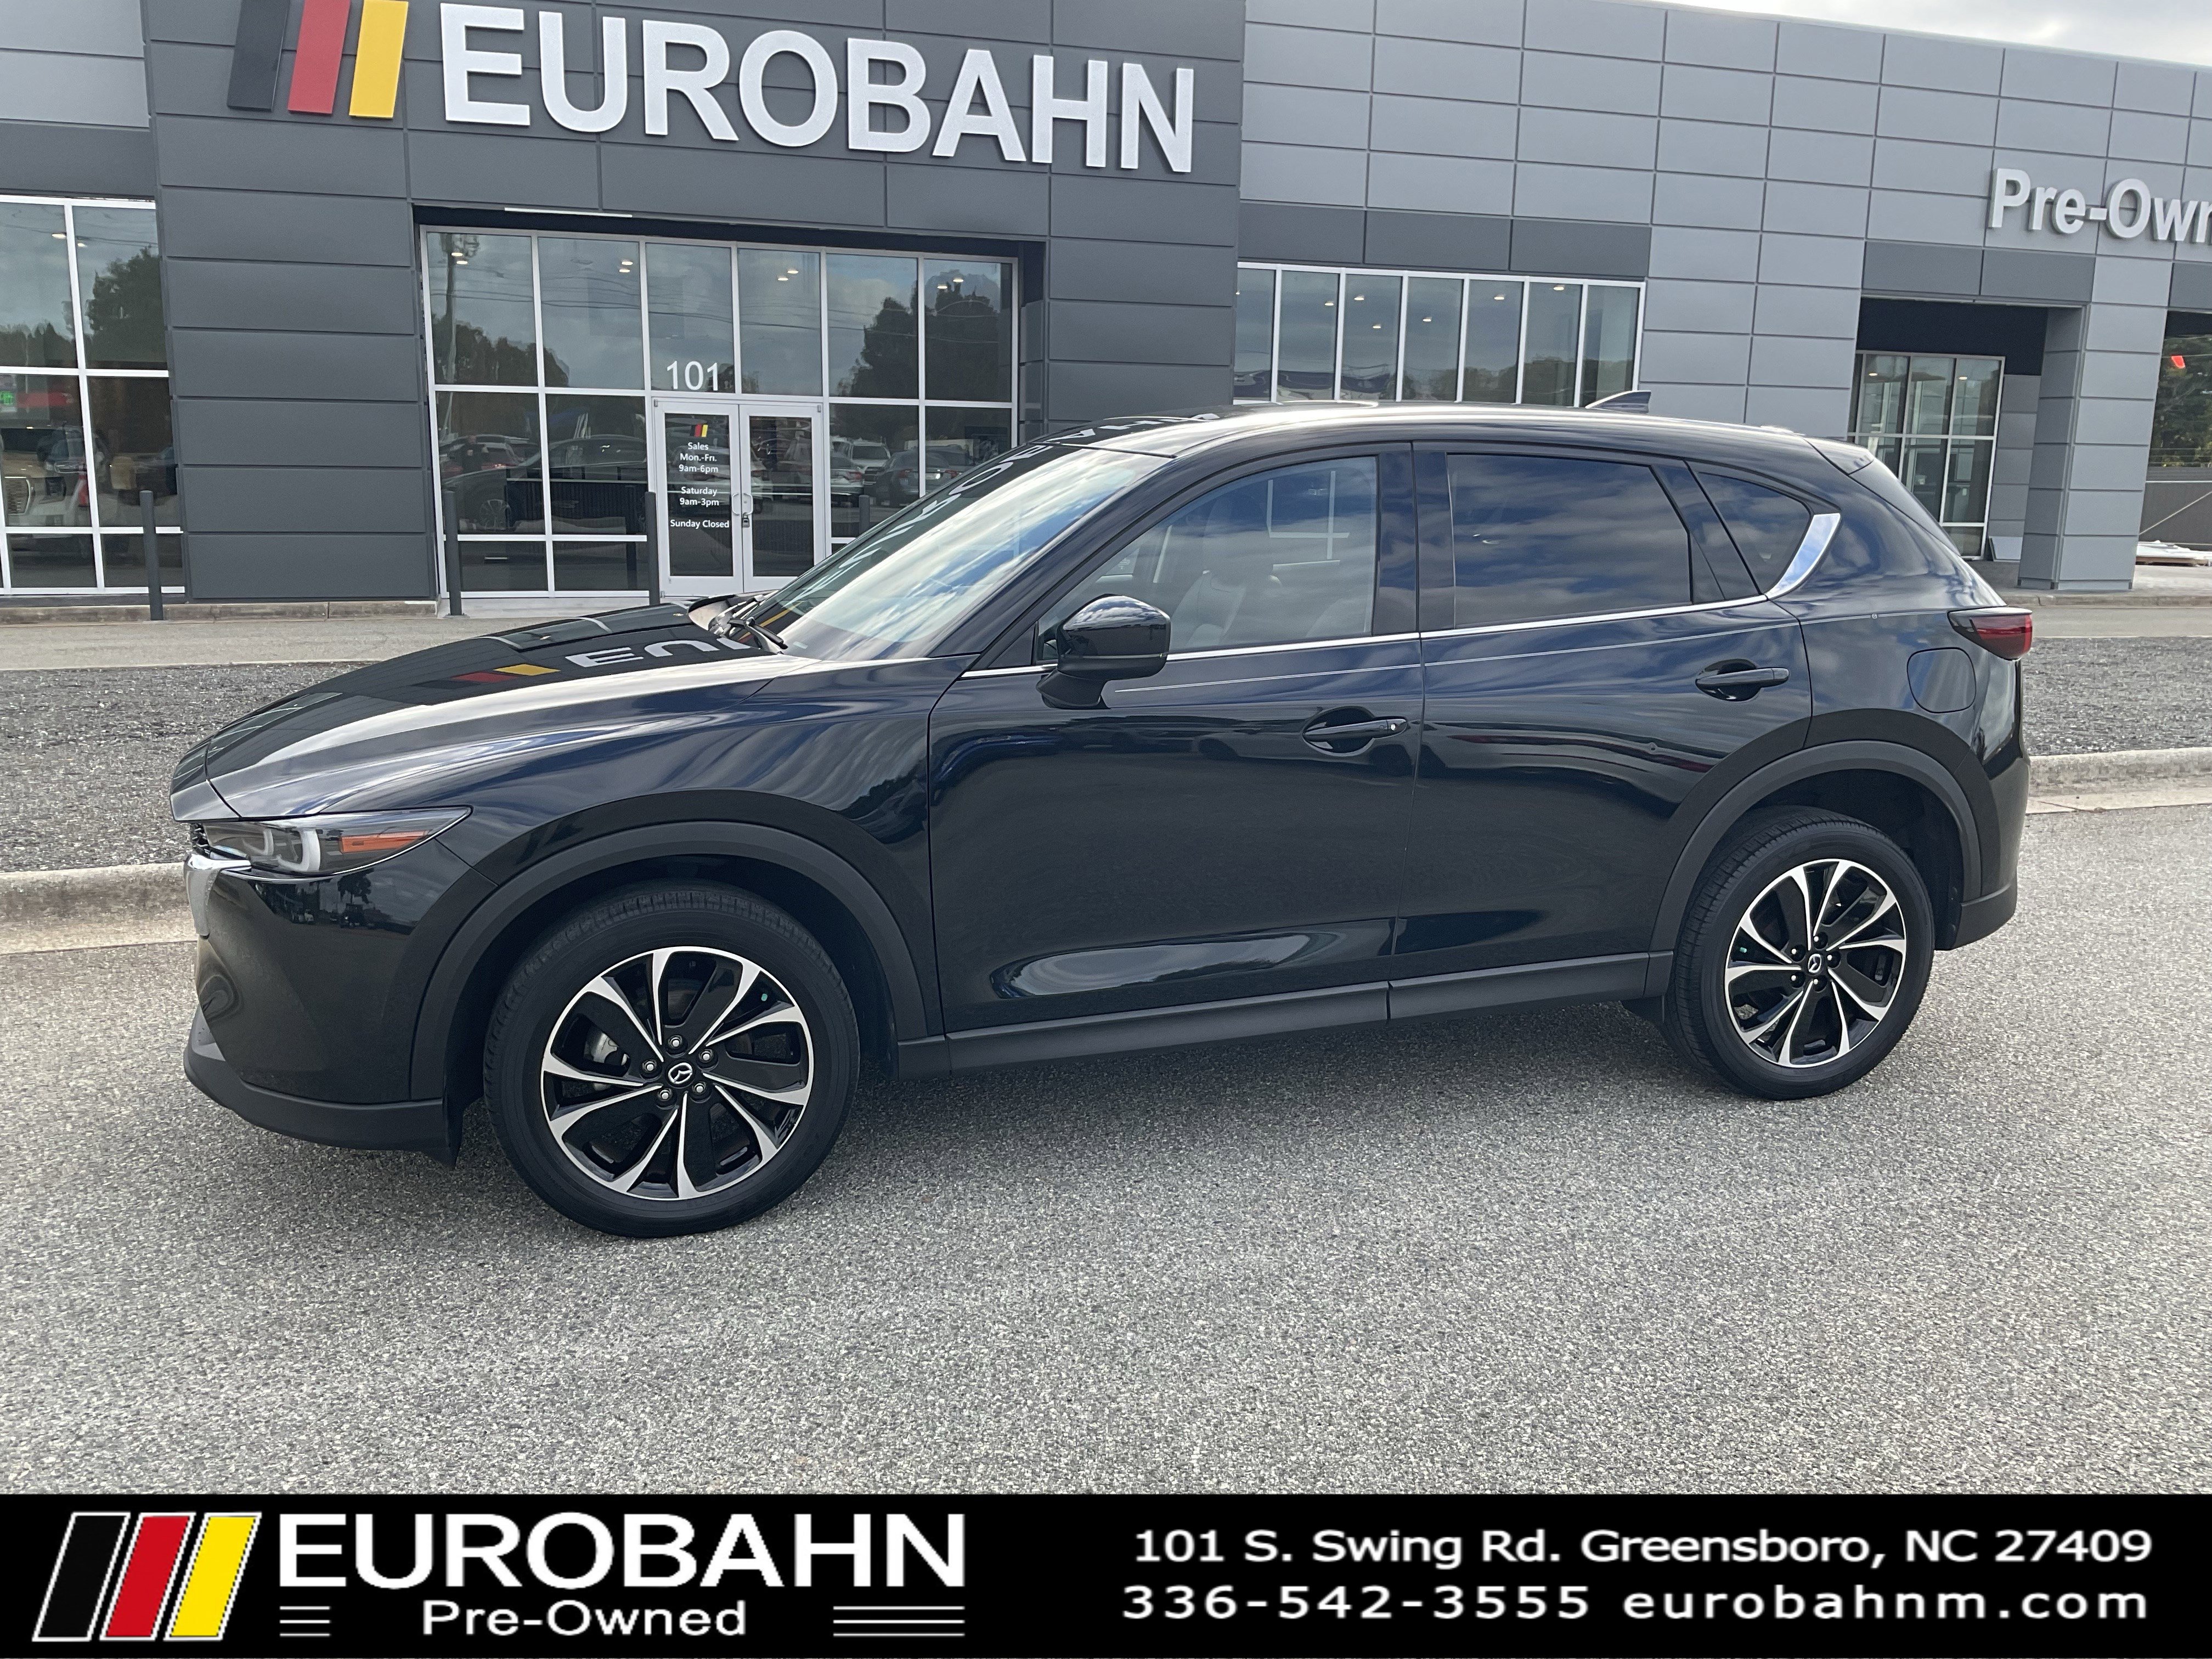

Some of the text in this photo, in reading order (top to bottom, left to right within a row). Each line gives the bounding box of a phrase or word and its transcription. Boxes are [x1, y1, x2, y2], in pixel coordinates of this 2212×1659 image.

[441, 3, 1194, 173] EUROBAHN
[666, 360, 718, 391] 101
[687, 442, 709, 450] Sales
[680, 453, 717, 462] Mon.-Fri.
[679, 464, 719, 475] 9am-6pm
[681, 486, 718, 496] Saturday
[679, 497, 719, 507] 9am-3pm
[670, 519, 730, 529] Sunday Closed
